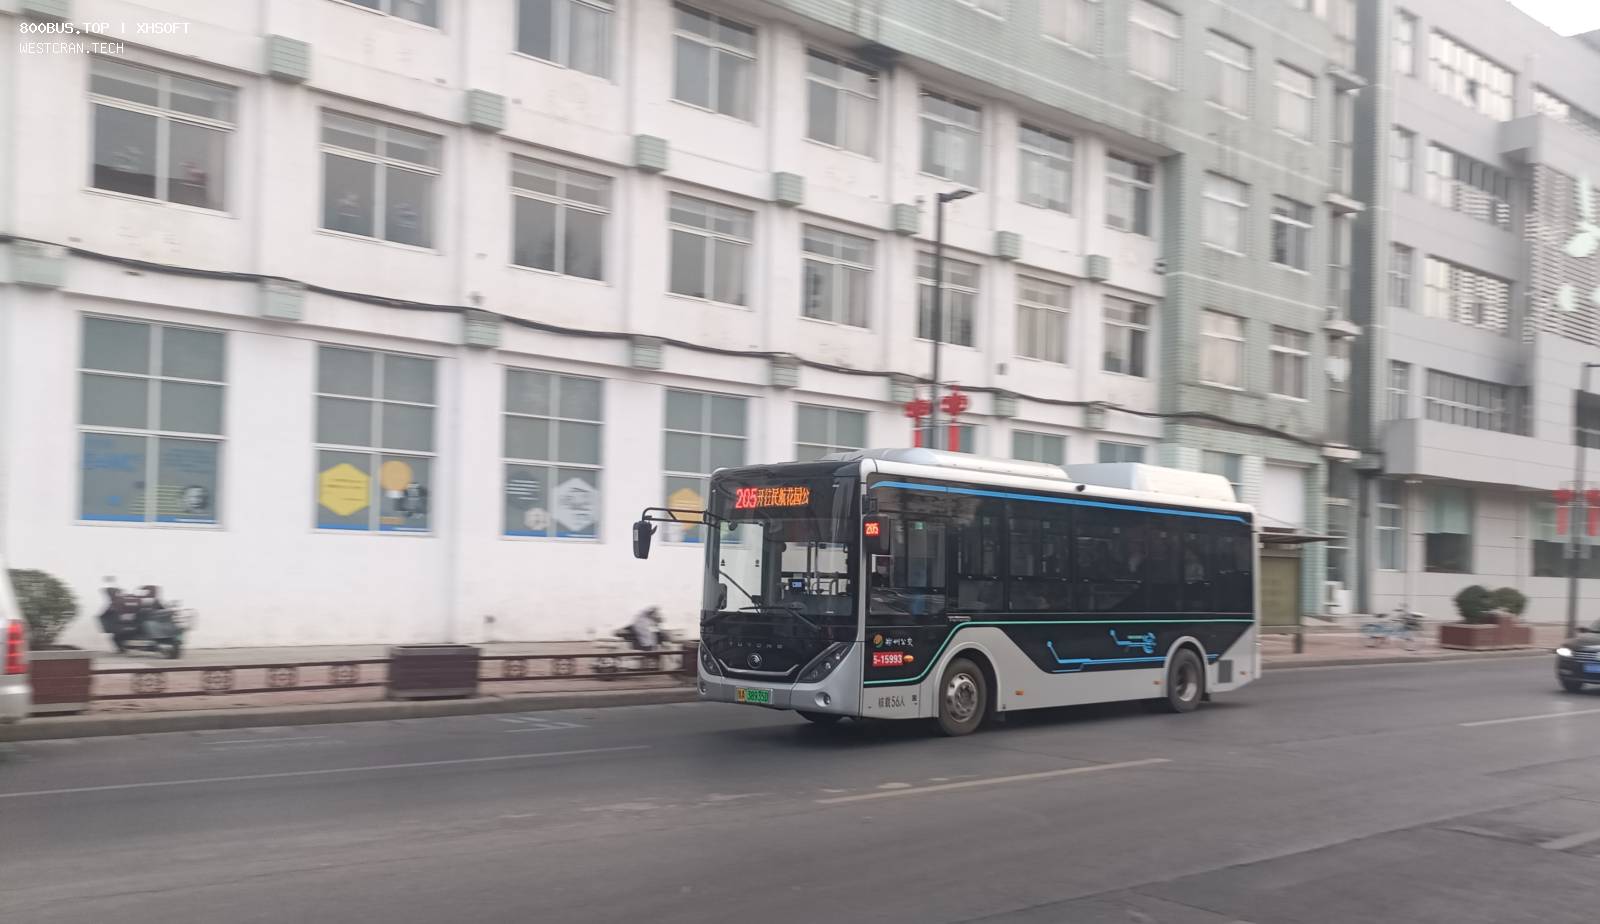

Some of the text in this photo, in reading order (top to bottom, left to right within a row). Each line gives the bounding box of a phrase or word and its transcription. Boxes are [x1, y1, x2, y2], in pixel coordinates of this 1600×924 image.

[735, 488, 757, 509] 205
[864, 523, 879, 535] 205
[872, 654, 904, 665] 5-15993
